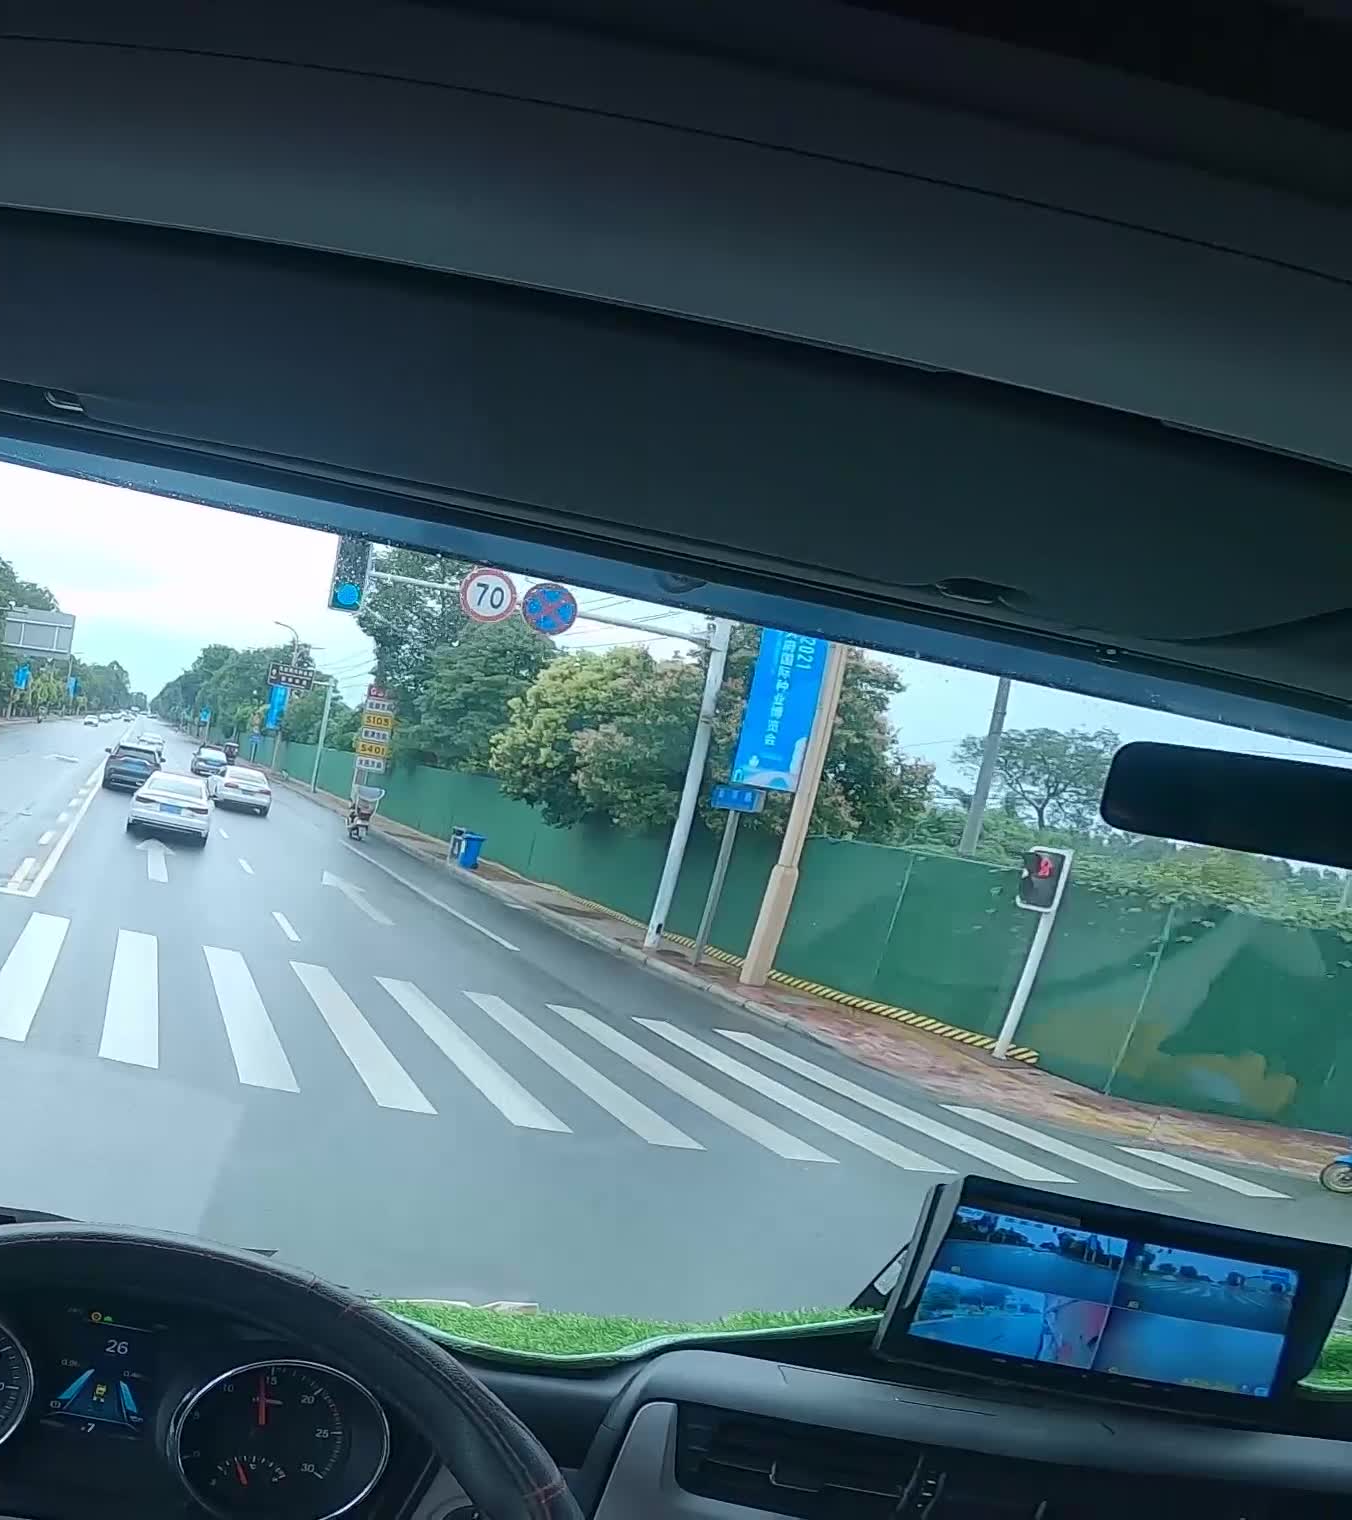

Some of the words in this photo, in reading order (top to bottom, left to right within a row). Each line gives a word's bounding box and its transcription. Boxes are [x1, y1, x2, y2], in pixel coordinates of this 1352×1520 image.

[476, 582, 505, 609] 70
[795, 636, 816, 670] 2021
[360, 743, 385, 755] S401
[105, 1339, 129, 1355] 26
[301, 1395, 315, 1404] 20
[315, 1429, 329, 1438] 25
[301, 1463, 315, 1473] 30
